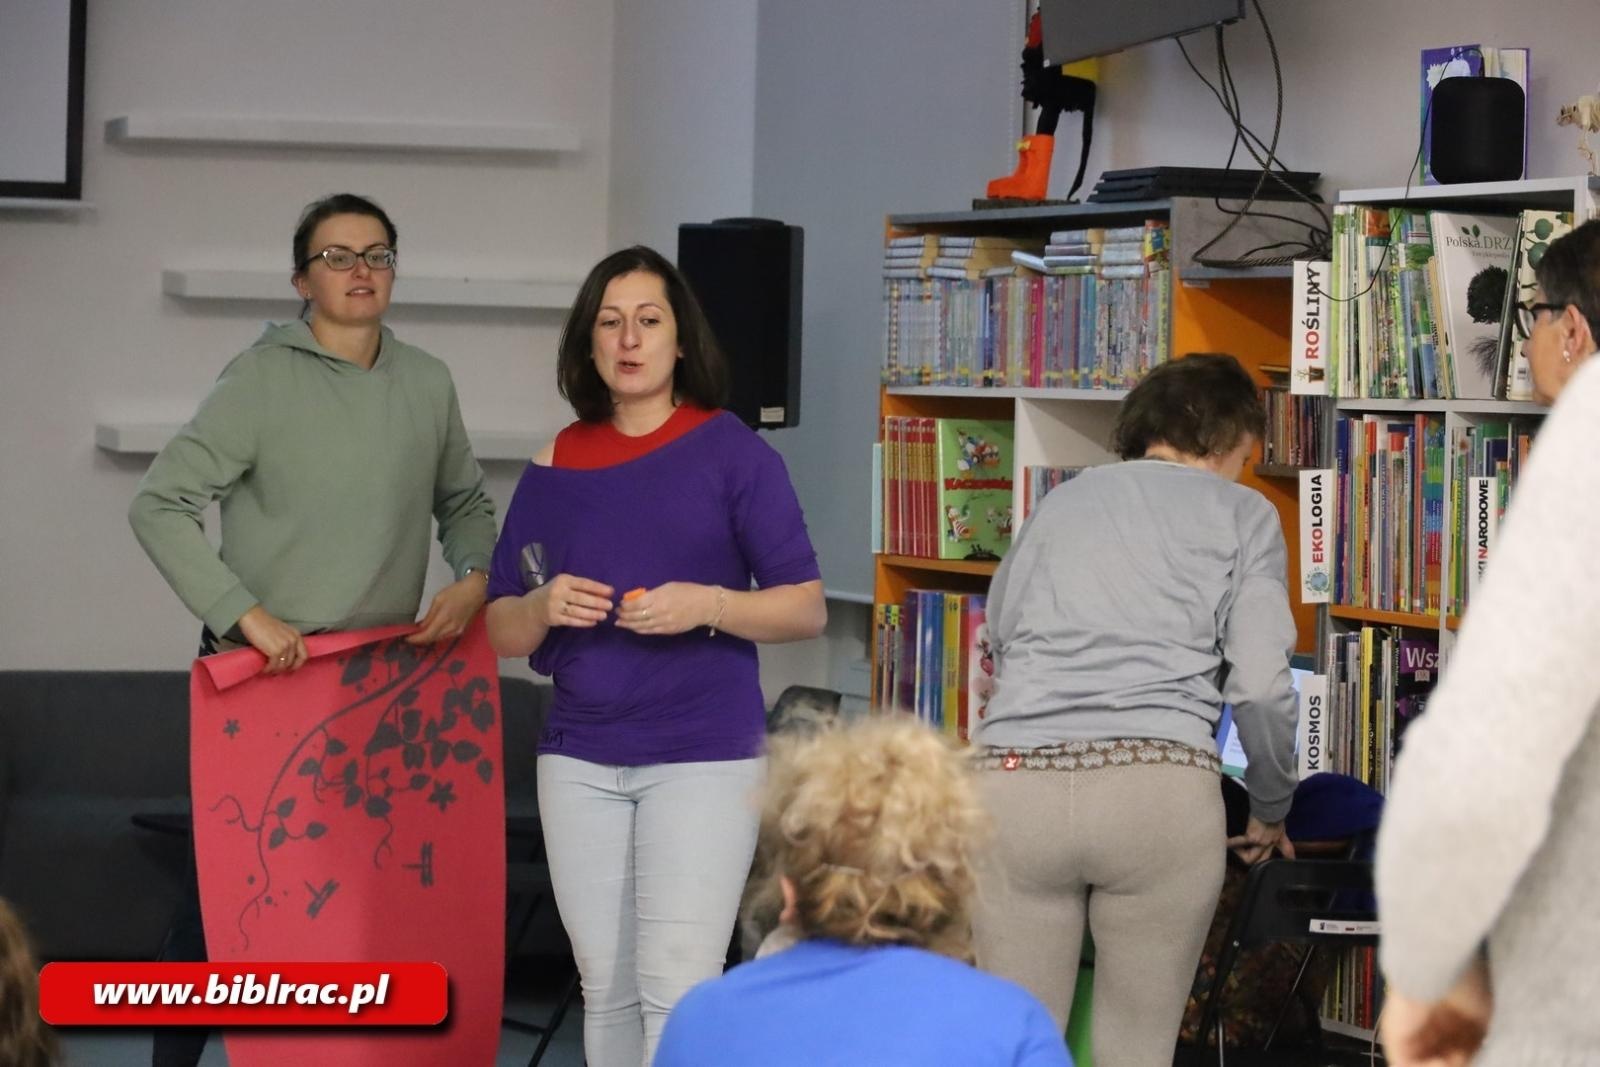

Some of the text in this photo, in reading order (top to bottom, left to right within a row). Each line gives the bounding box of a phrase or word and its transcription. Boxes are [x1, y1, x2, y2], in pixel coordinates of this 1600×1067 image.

[1301, 266, 1320, 360] ROŚLINY
[1310, 474, 1324, 564] EKOLOGIA
[1478, 480, 1489, 559] NARODOWE
[1308, 695, 1321, 770] KOSMOS
